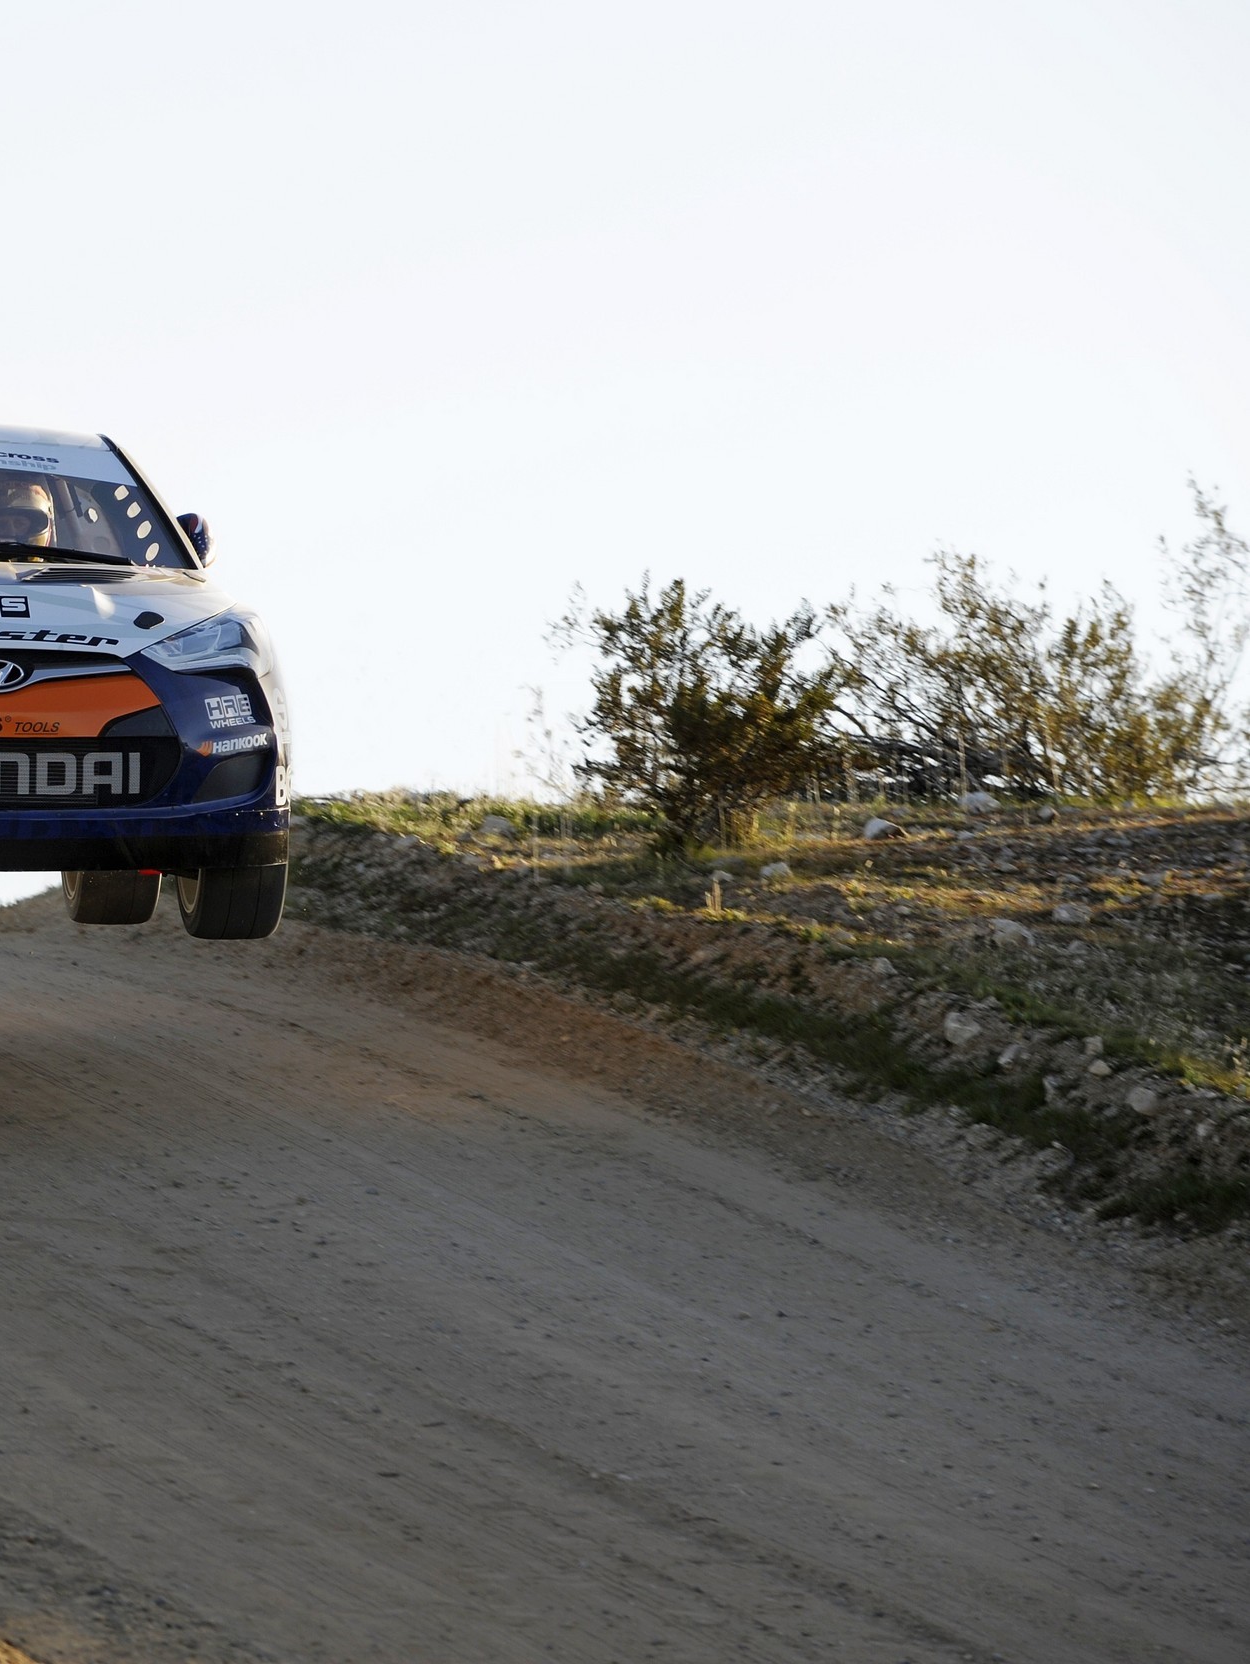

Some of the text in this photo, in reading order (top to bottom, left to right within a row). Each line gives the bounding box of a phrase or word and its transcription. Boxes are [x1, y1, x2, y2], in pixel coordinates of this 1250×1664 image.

[205, 694, 252, 720] HRE
[15, 721, 60, 733] TOOLS
[210, 716, 256, 729] WHEELS
